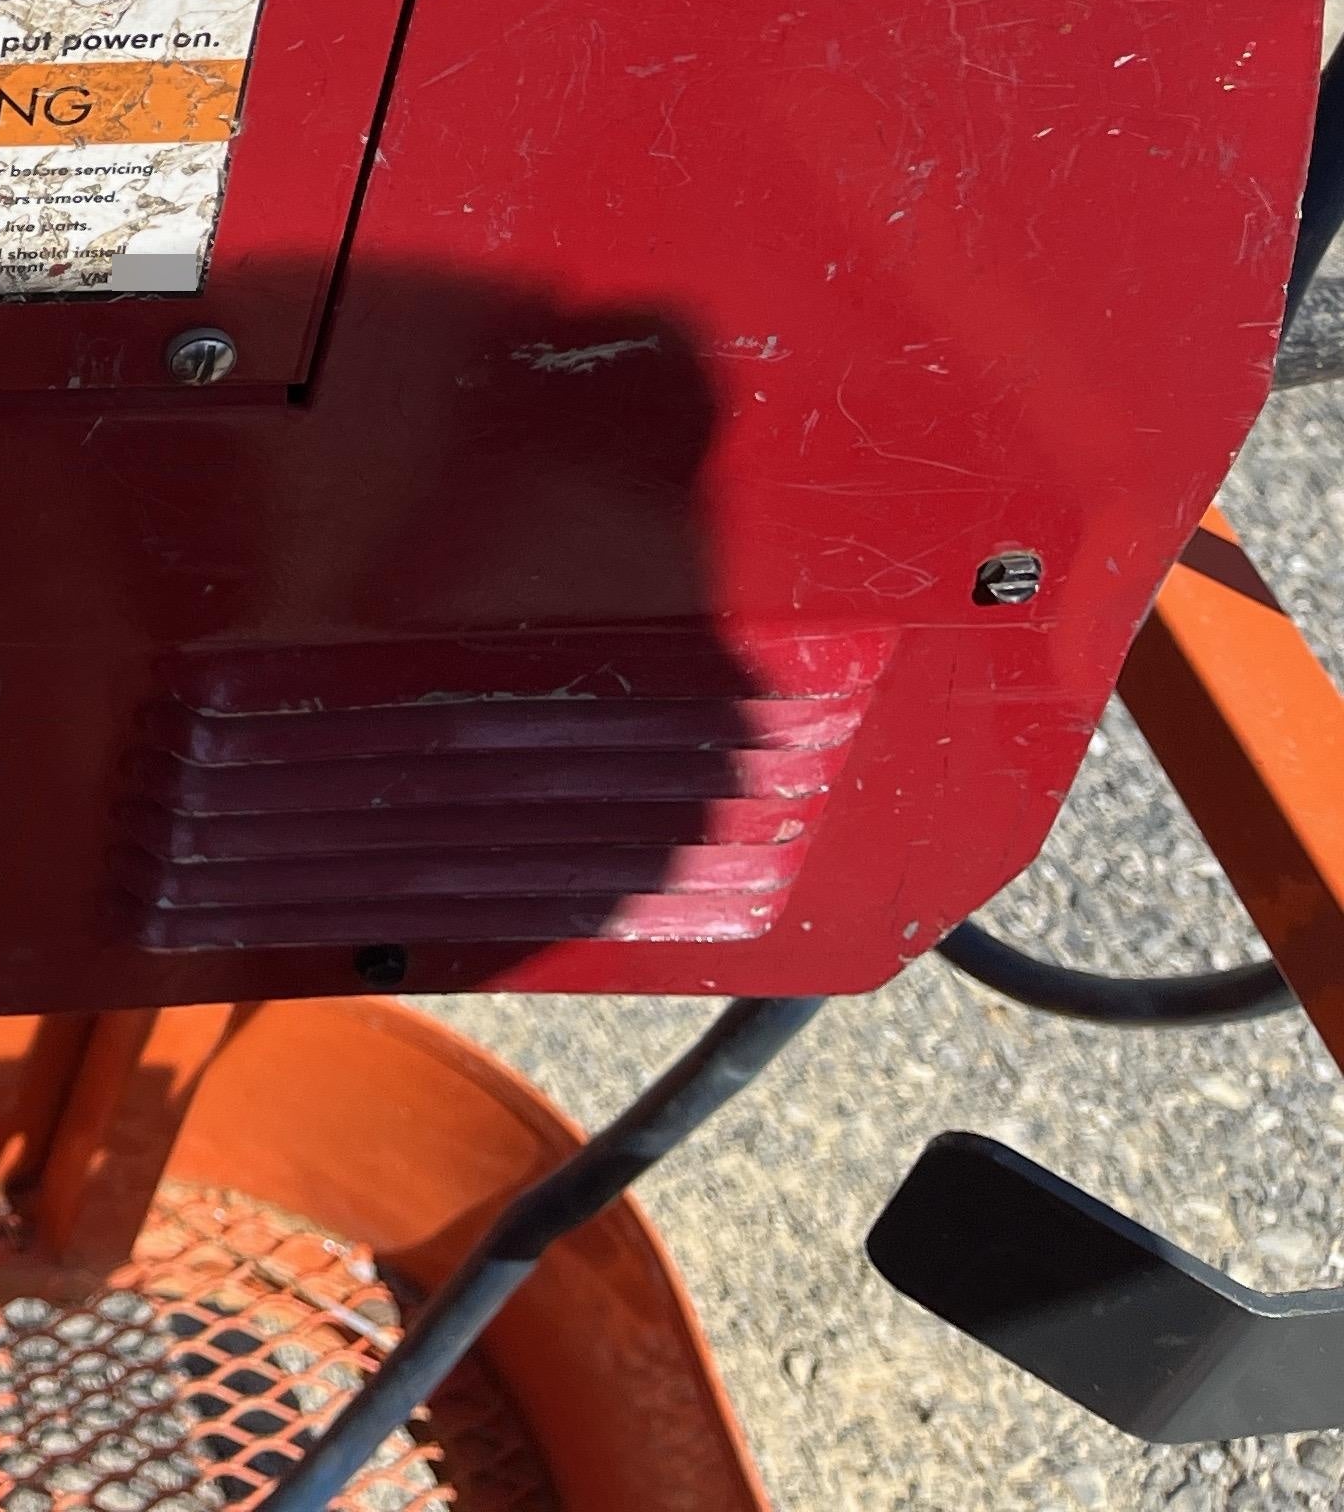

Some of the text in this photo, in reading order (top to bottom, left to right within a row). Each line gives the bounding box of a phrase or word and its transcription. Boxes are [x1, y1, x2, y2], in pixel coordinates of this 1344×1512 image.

[62, 33, 163, 57] power
[172, 29, 222, 50] on.
[73, 161, 160, 179] servicing.
[36, 190, 122, 207] removed.
[4, 220, 36, 235] live
